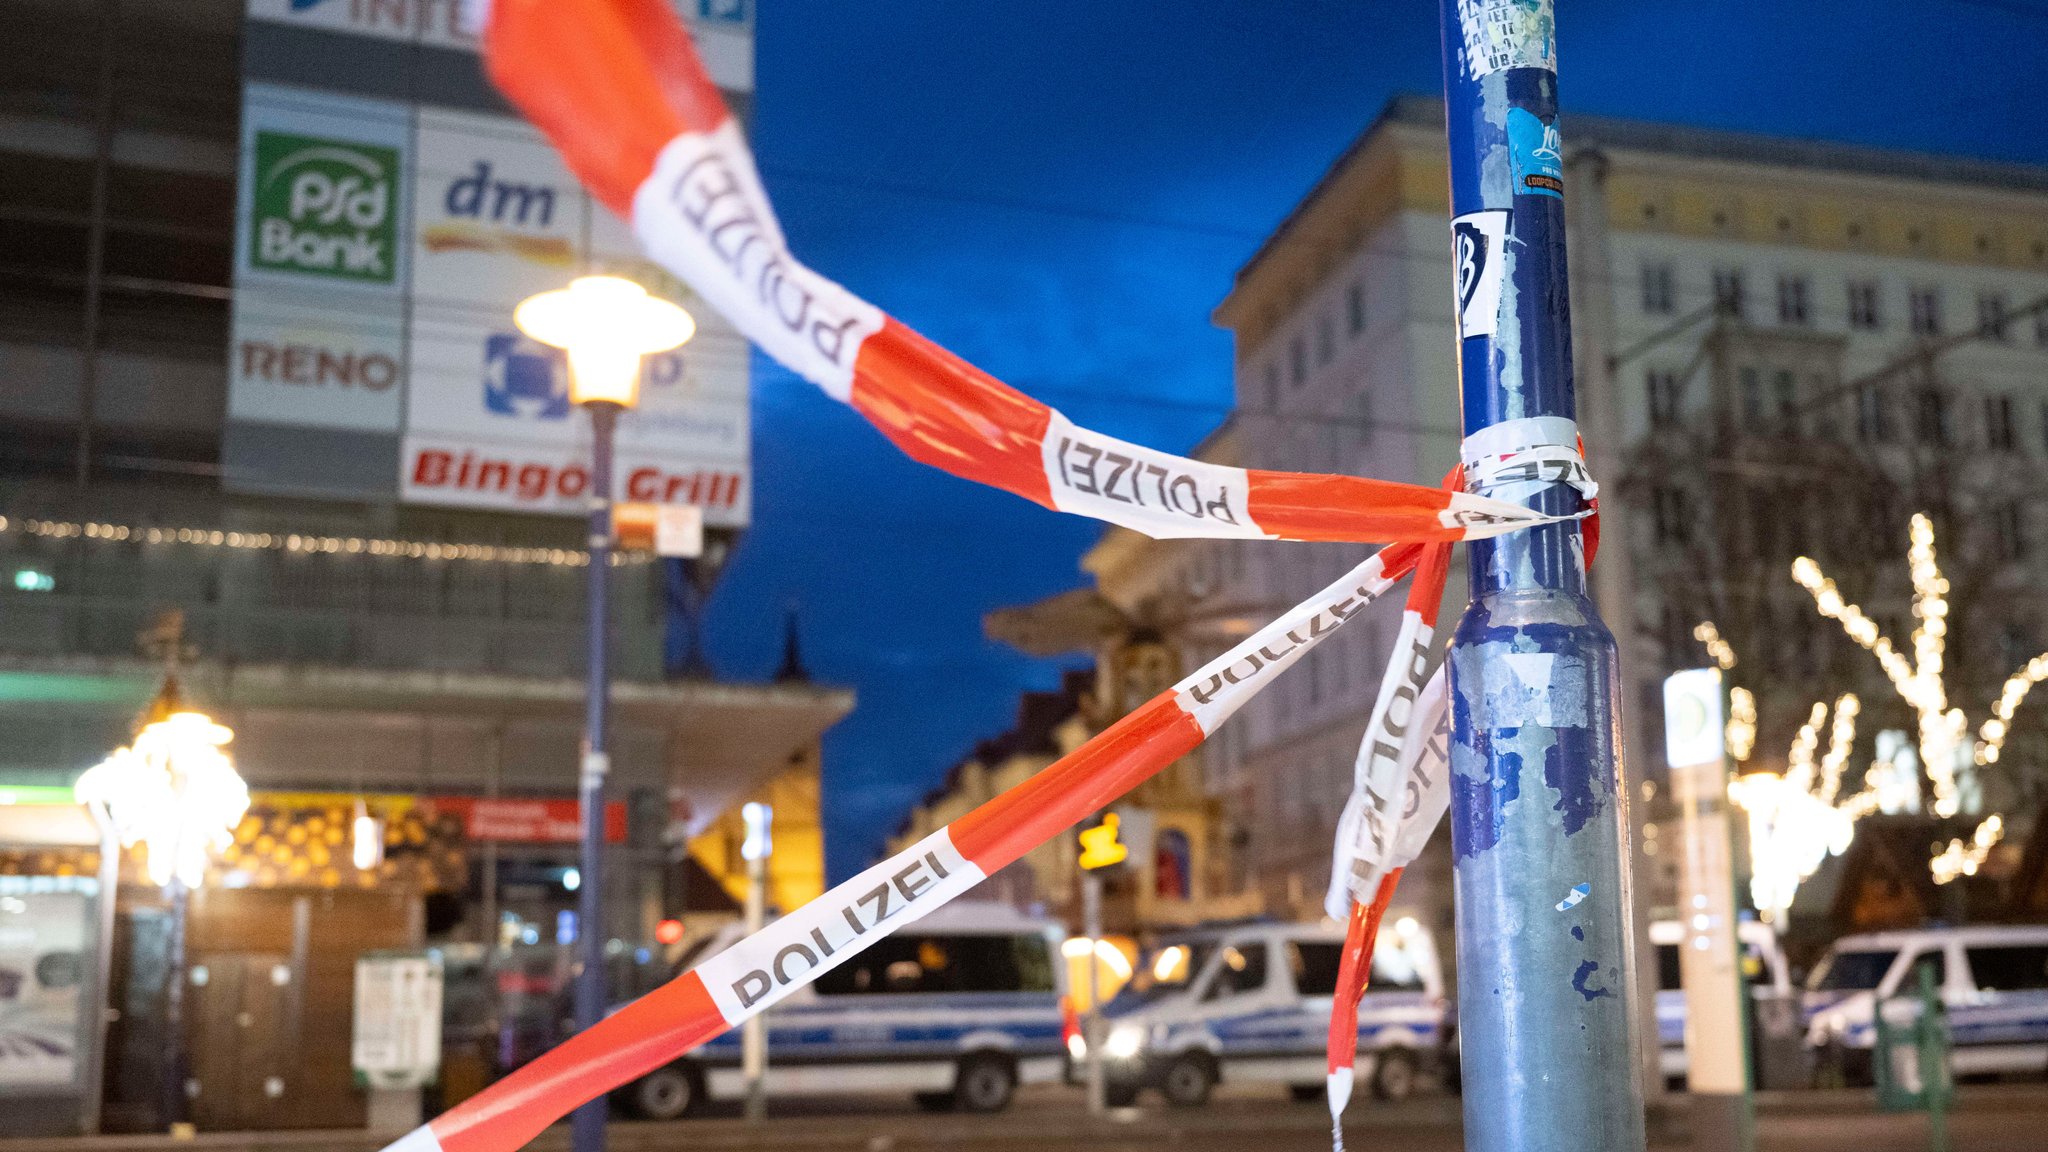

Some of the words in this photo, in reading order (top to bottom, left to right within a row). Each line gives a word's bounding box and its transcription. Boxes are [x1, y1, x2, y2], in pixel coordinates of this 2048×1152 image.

[444, 162, 556, 227] dm
[260, 219, 384, 275] Bank
[240, 340, 398, 392] RENO
[411, 448, 588, 499] Bingo
[626, 467, 741, 508] Grill
[1058, 436, 1240, 527] POLIZEI
[1189, 586, 1376, 705] POLIZEI
[730, 850, 952, 1010] POLIZEI
